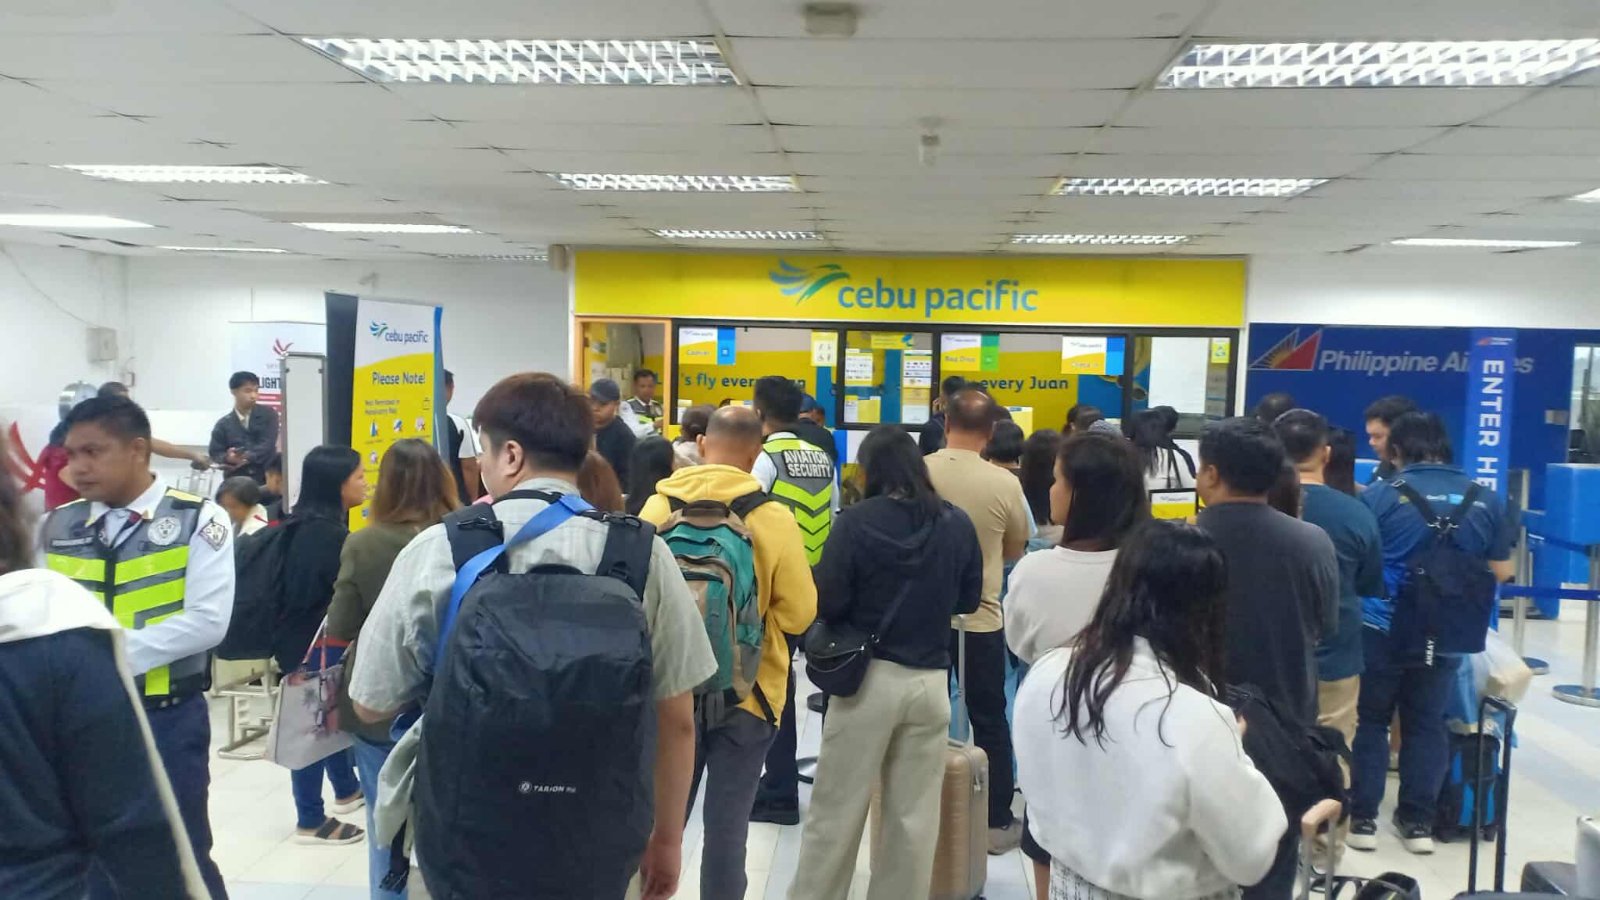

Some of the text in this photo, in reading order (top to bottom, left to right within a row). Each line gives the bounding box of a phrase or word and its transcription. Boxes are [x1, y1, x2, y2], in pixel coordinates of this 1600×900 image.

[838, 278, 1039, 318] cebu pacific
[385, 328, 429, 345] cebu pacific
[1318, 350, 1439, 376] Philippine
[257, 376, 282, 389] LIGHT
[372, 371, 426, 385] Please Note!
[697, 372, 717, 390] fly
[721, 377, 757, 388] ever
[981, 376, 1069, 393] every Juan
[1478, 359, 1505, 447] ENTER
[784, 450, 829, 464] AVIATION
[787, 463, 832, 477] SECURITY
[1475, 456, 1499, 491] HE
